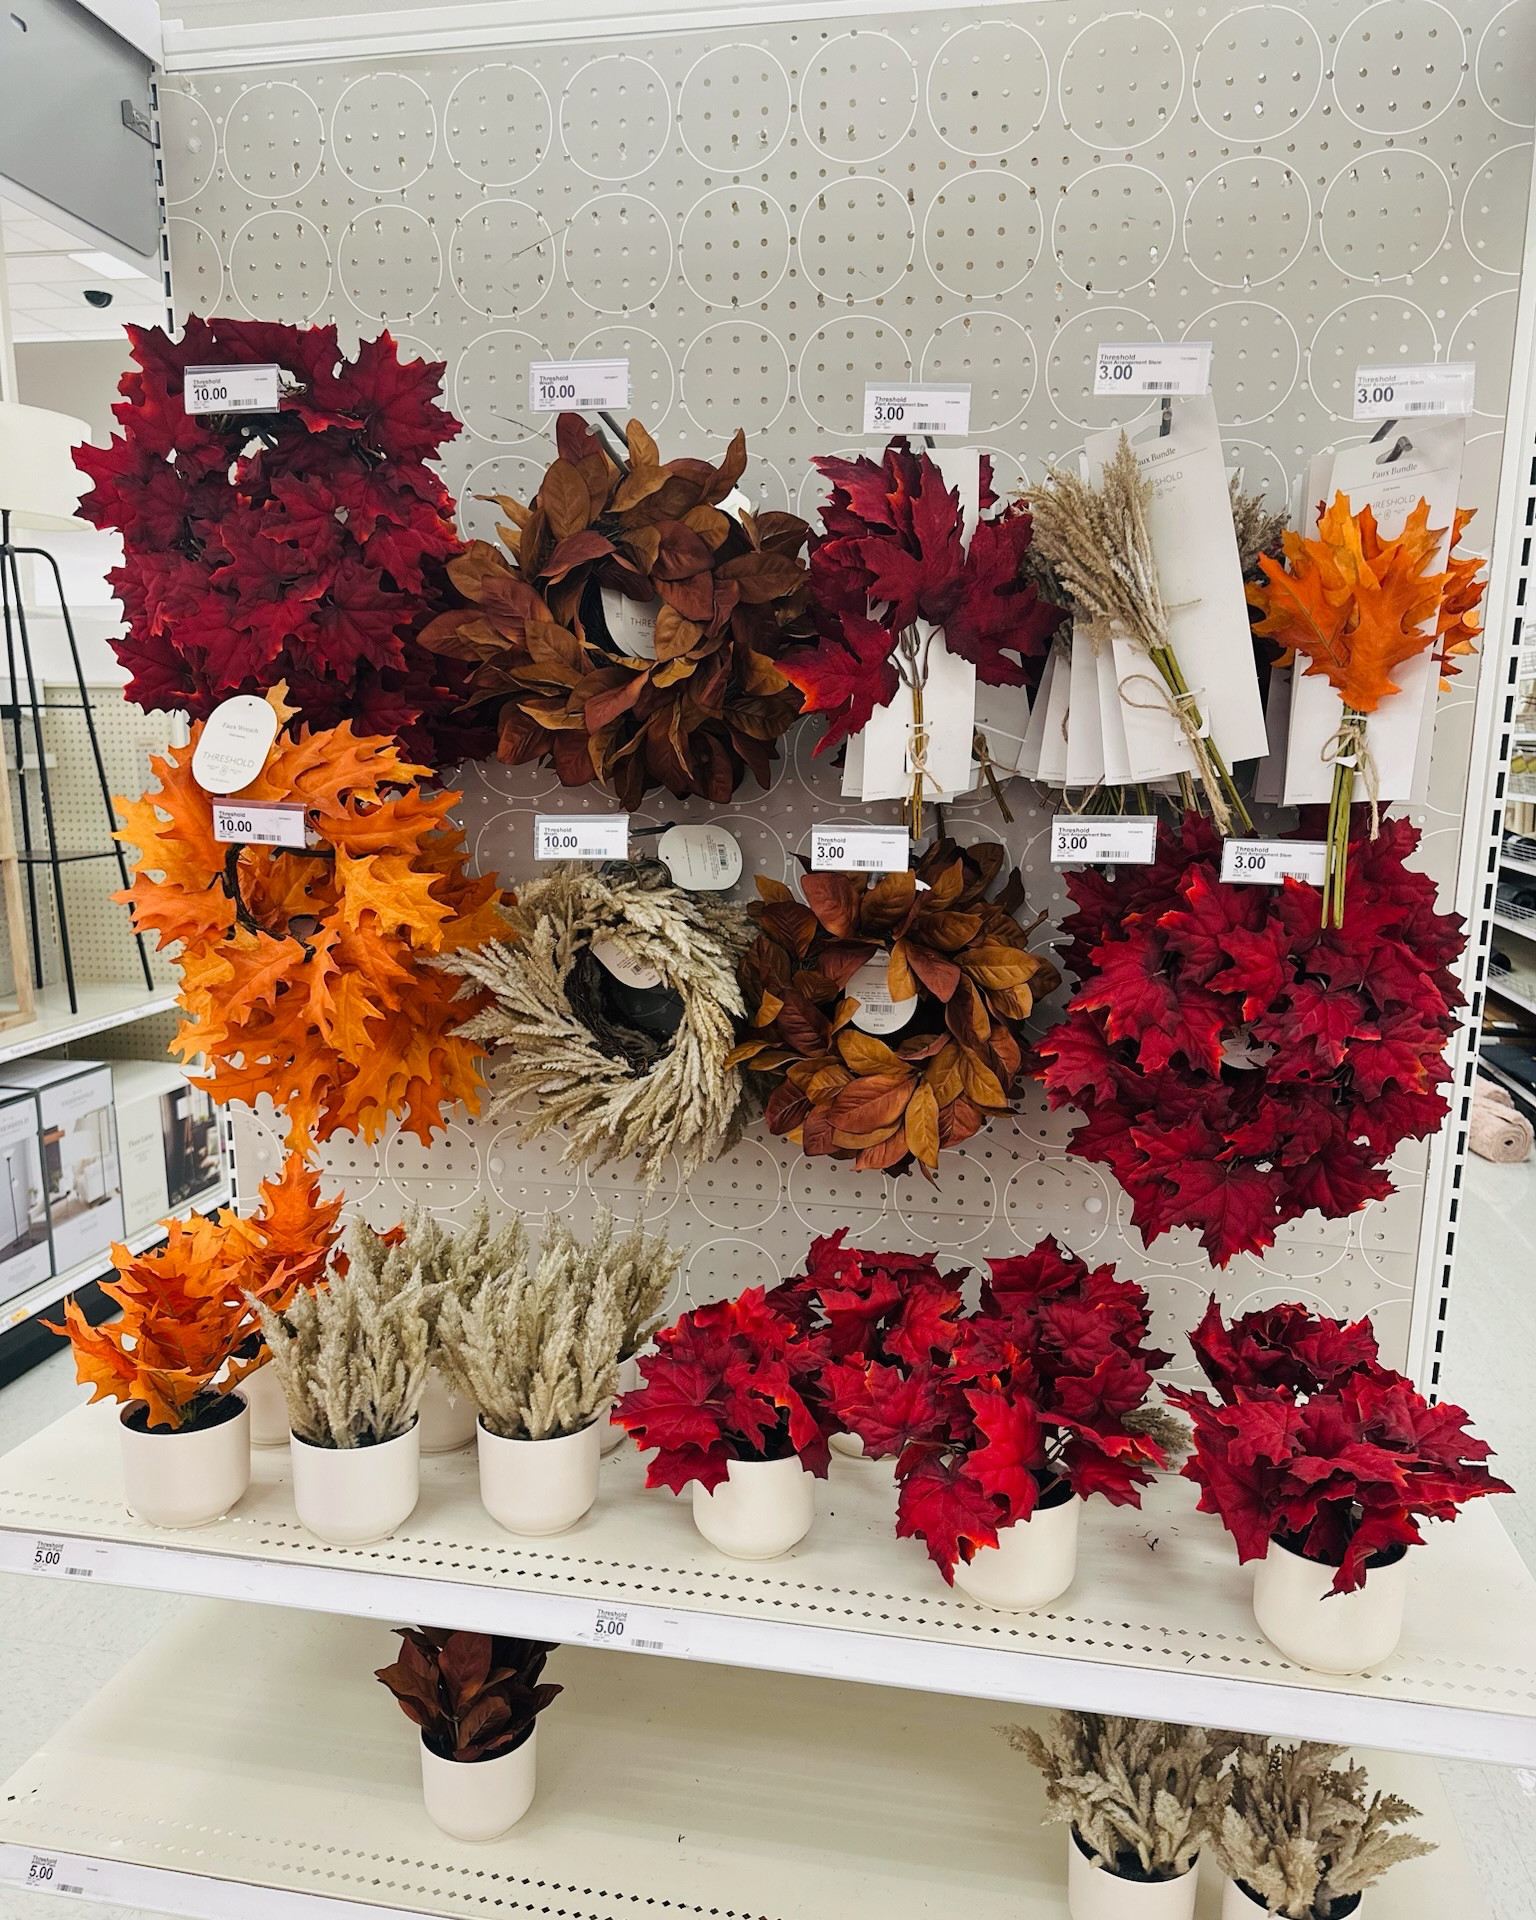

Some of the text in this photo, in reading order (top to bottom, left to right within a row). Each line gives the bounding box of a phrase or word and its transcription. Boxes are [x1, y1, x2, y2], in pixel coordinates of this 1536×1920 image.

[1099, 365, 1133, 380] 3.00
[194, 387, 227, 400] 10.00
[540, 384, 575, 399] 10.00
[1358, 386, 1394, 403] 3.00
[874, 406, 904, 421] 3.00
[1137, 447, 1176, 467] aux Bundle
[1371, 463, 1418, 480] Faux Bundle
[1372, 494, 1416, 509] HRESHOLD
[630, 617, 656, 629] THRES
[222, 722, 259, 734] Faux Wreath
[202, 751, 255, 769] THRESHOLD
[219, 819, 252, 833] 10.00
[544, 836, 578, 848] 10.00
[1058, 836, 1088, 850] 3.00
[817, 846, 845, 859] 3.00
[1234, 855, 1266, 870] 3.00
[37, 1541, 64, 1549] Threshold
[34, 1550, 60, 1565] 5.00
[597, 1608, 628, 1618] Threshold
[595, 1619, 624, 1636] 5.00
[33, 1855, 57, 1864] Threshold
[29, 1864, 54, 1880] 5.00
